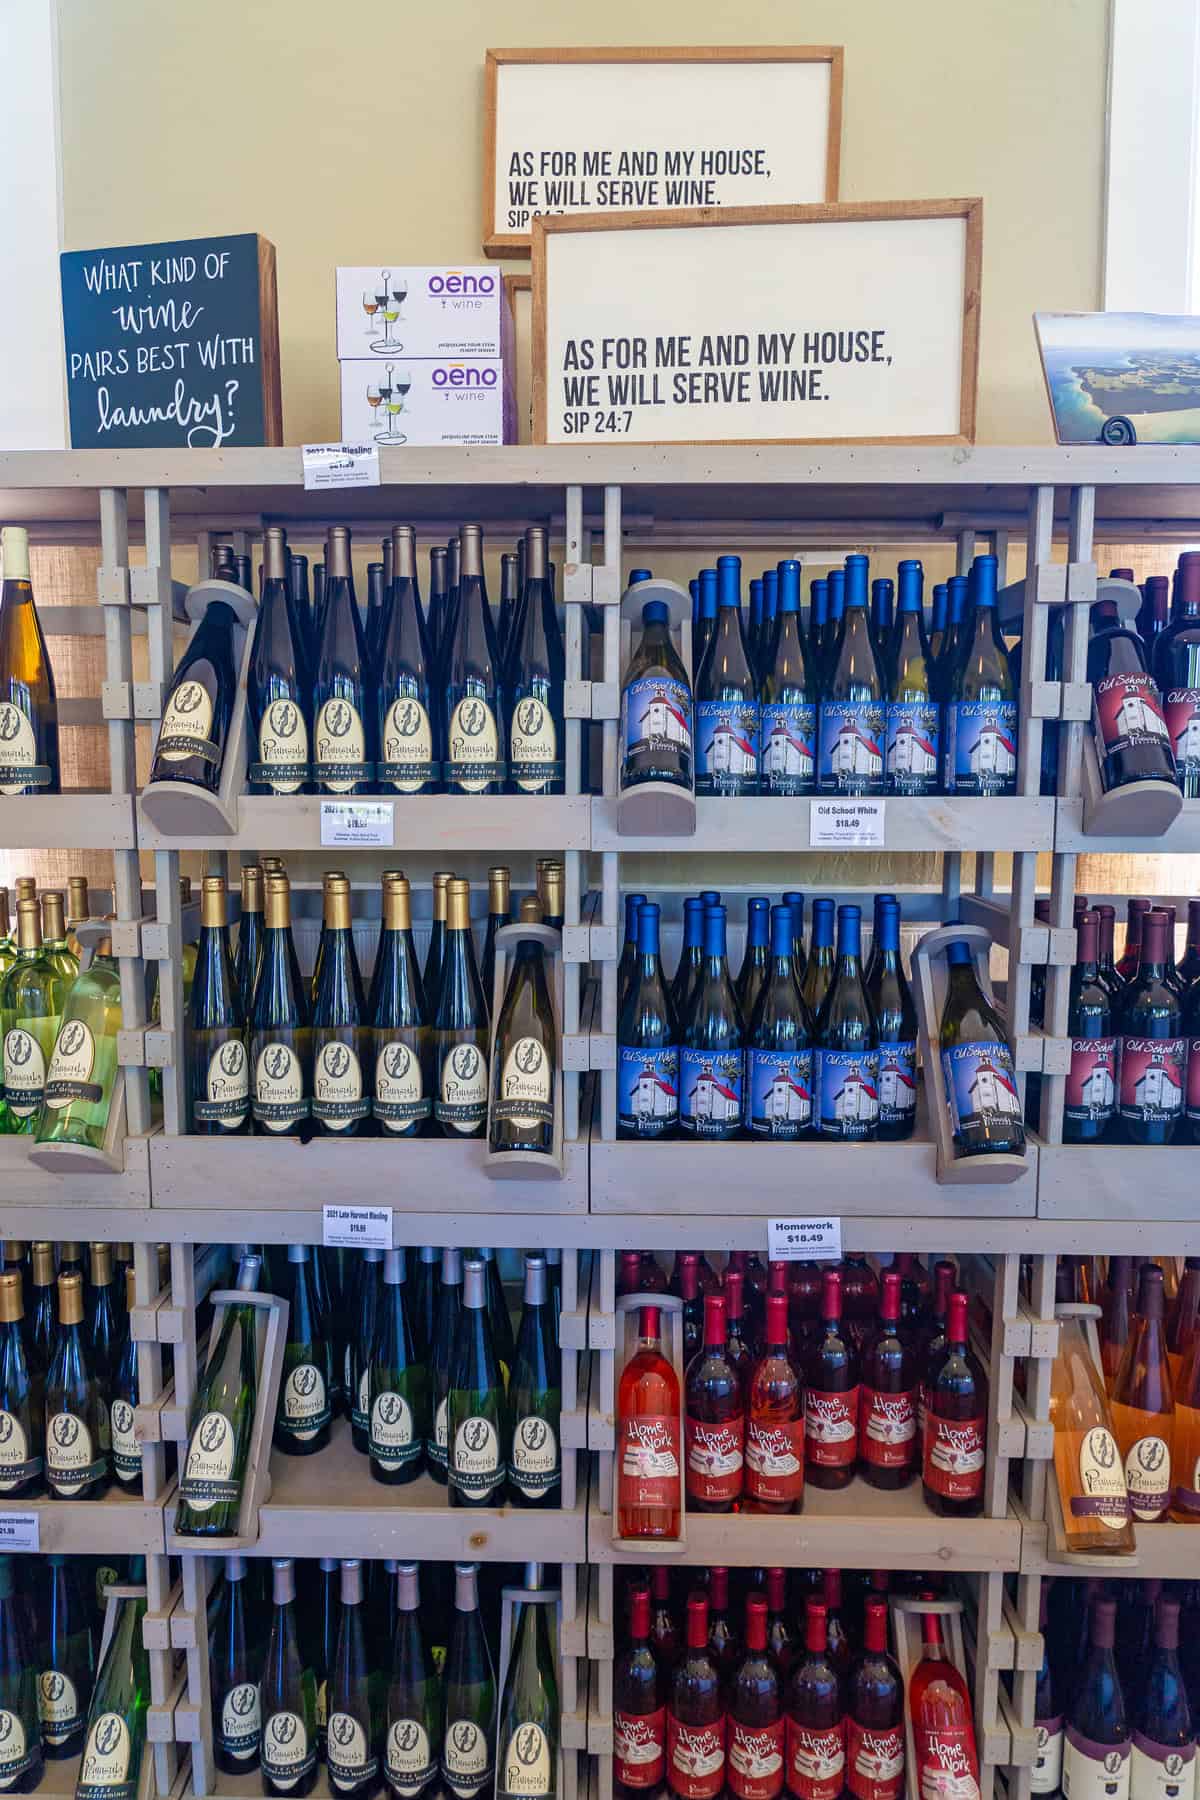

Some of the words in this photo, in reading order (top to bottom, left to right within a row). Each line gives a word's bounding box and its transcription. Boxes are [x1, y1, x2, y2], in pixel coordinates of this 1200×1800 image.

[509, 151, 534, 177] AS
[540, 151, 577, 177] FOR
[583, 151, 612, 176] ME
[618, 151, 658, 176] AND
[665, 150, 695, 176] MY
[700, 150, 771, 178] HOUSE,
[509, 181, 538, 206] WE
[545, 181, 590, 206] WILL
[597, 180, 659, 205] SERVE
[665, 179, 721, 205] WINE.
[508, 210, 530, 228] SIP
[83, 259, 143, 295] WHAT
[151, 256, 196, 286] KIND
[204, 252, 231, 279] OF
[452, 298, 482, 309] wine
[111, 294, 205, 334] wine
[71, 349, 129, 381] PAIRS
[137, 343, 190, 374] BEST
[198, 333, 254, 370] WITH
[563, 339, 594, 371] AS
[601, 338, 647, 370] FOR
[655, 336, 692, 367] ME
[699, 335, 749, 367] AND
[757, 333, 796, 366] MY
[803, 330, 893, 367] HOUSE,
[456, 392, 485, 401] wine
[563, 375, 600, 407] WE
[607, 373, 666, 406] WILL
[673, 371, 751, 404] SERVE
[759, 370, 830, 402] WINE.
[97, 378, 239, 448] laundry?
[563, 412, 589, 434] SIP
[595, 411, 633, 433] 24:7
[342, 446, 372, 455] Riesling
[1099, 679, 1115, 693] Old
[1115, 675, 1147, 686] School
[1168, 692, 1184, 703] Old
[818, 806, 830, 814] Old
[832, 806, 856, 815] School
[857, 806, 878, 815] White
[836, 819, 860, 828] $18.49
[1073, 1041, 1091, 1051] Old
[1127, 1040, 1144, 1052] Old
[1144, 1041, 1175, 1053] School
[775, 1222, 833, 1231] Homework
[787, 1234, 823, 1243] $18.49
[807, 1393, 840, 1410] Home
[873, 1395, 907, 1411] Home
[817, 1405, 849, 1421] Work
[628, 1421, 665, 1438] Home
[696, 1427, 730, 1442] Home
[750, 1422, 783, 1440] Home
[937, 1423, 973, 1440] Home
[640, 1434, 673, 1450] Work
[707, 1437, 739, 1453] Work
[759, 1437, 794, 1453] Work
[951, 1434, 982, 1451] Work
[615, 1712, 646, 1729] Home
[624, 1727, 655, 1743] Work
[678, 1728, 712, 1744] Home
[735, 1728, 768, 1744] Home
[800, 1732, 835, 1748] Home
[862, 1733, 896, 1749] Home
[689, 1738, 720, 1753] Work
[746, 1739, 778, 1755] Work
[814, 1739, 842, 1758] Work
[928, 1736, 962, 1756] Home
[939, 1753, 971, 1773] Work
